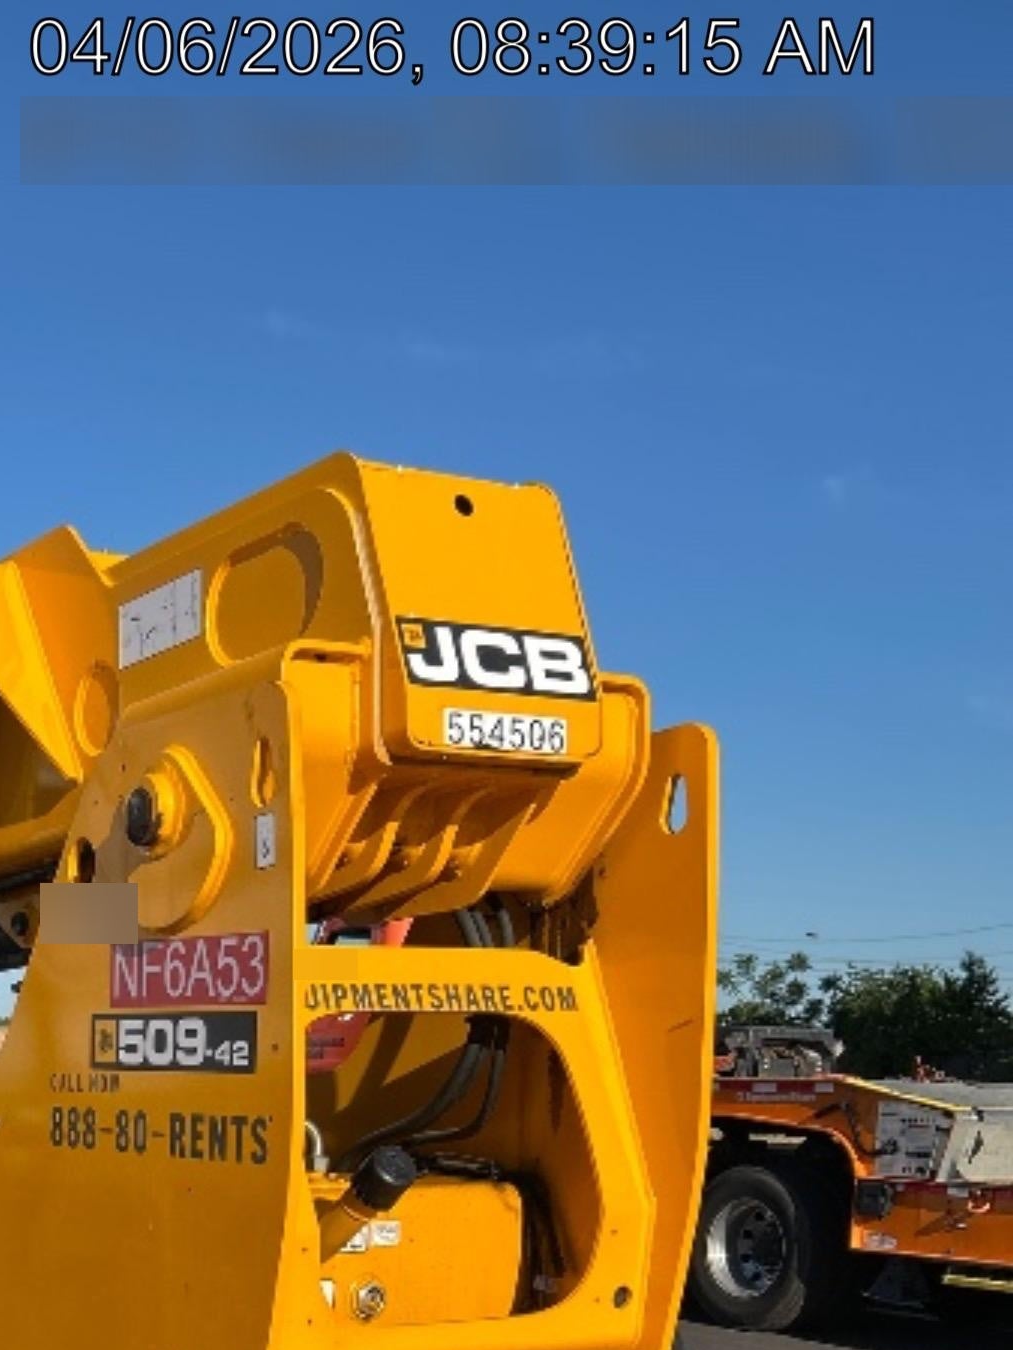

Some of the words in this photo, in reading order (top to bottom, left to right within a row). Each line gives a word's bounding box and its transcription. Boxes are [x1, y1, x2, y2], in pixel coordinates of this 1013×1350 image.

[407, 626, 590, 694] JCB
[448, 711, 565, 754] 554506
[114, 936, 264, 998] NF6A53
